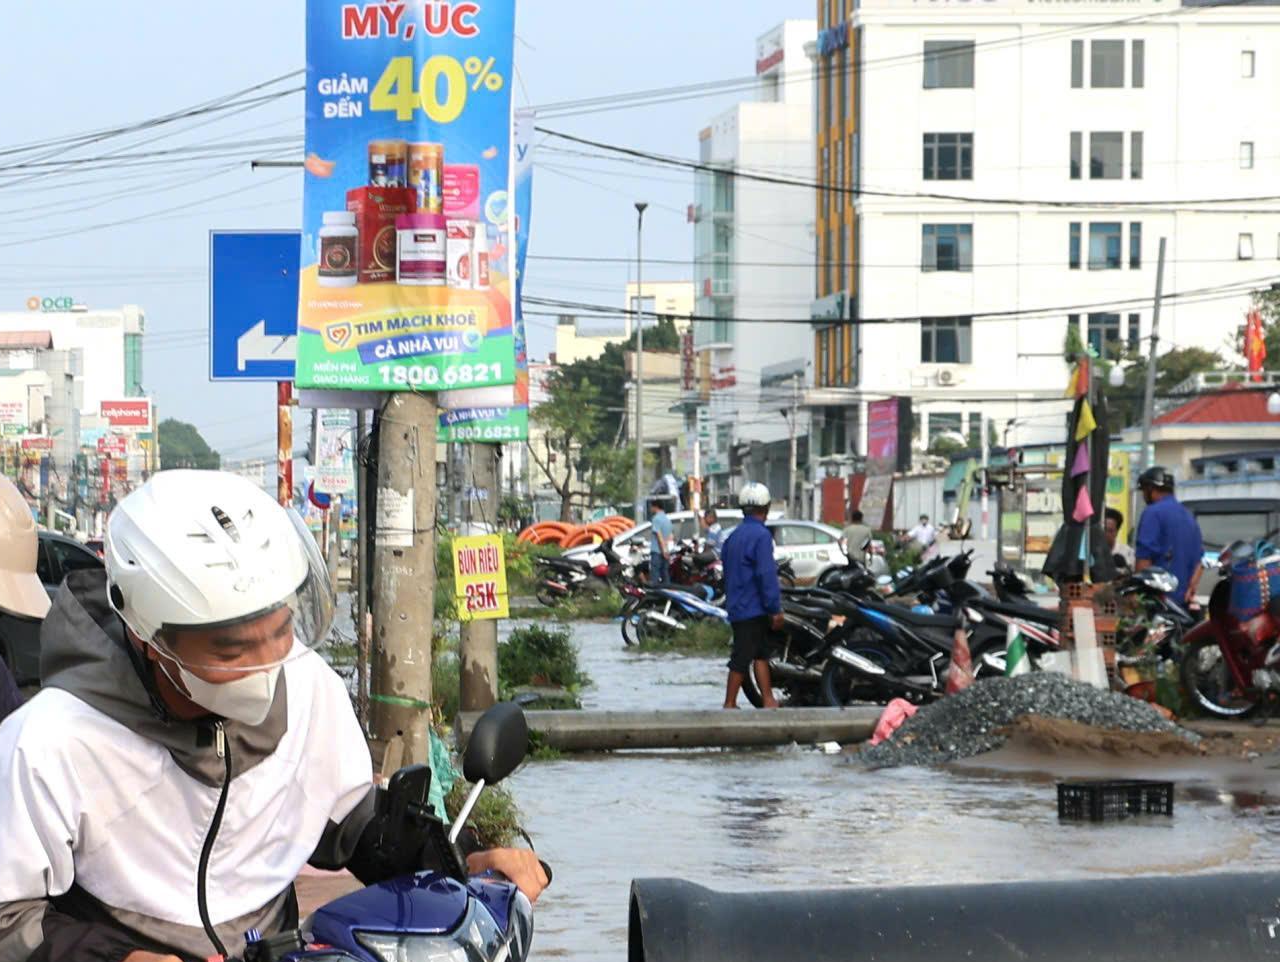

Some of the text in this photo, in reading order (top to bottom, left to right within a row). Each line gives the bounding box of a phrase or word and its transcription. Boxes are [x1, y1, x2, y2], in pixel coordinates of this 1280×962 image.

[318, 73, 368, 95] GIẢM
[370, 55, 503, 123] 40%
[324, 96, 362, 118] ĐẾN
[42, 296, 72, 310] OCB
[355, 321, 383, 335] TIM
[375, 336, 459, 358] CẢ NHÀ VUI
[378, 362, 502, 385] 1800 6821
[451, 425, 520, 439] 1800 6821
[465, 582, 497, 611] 25K
